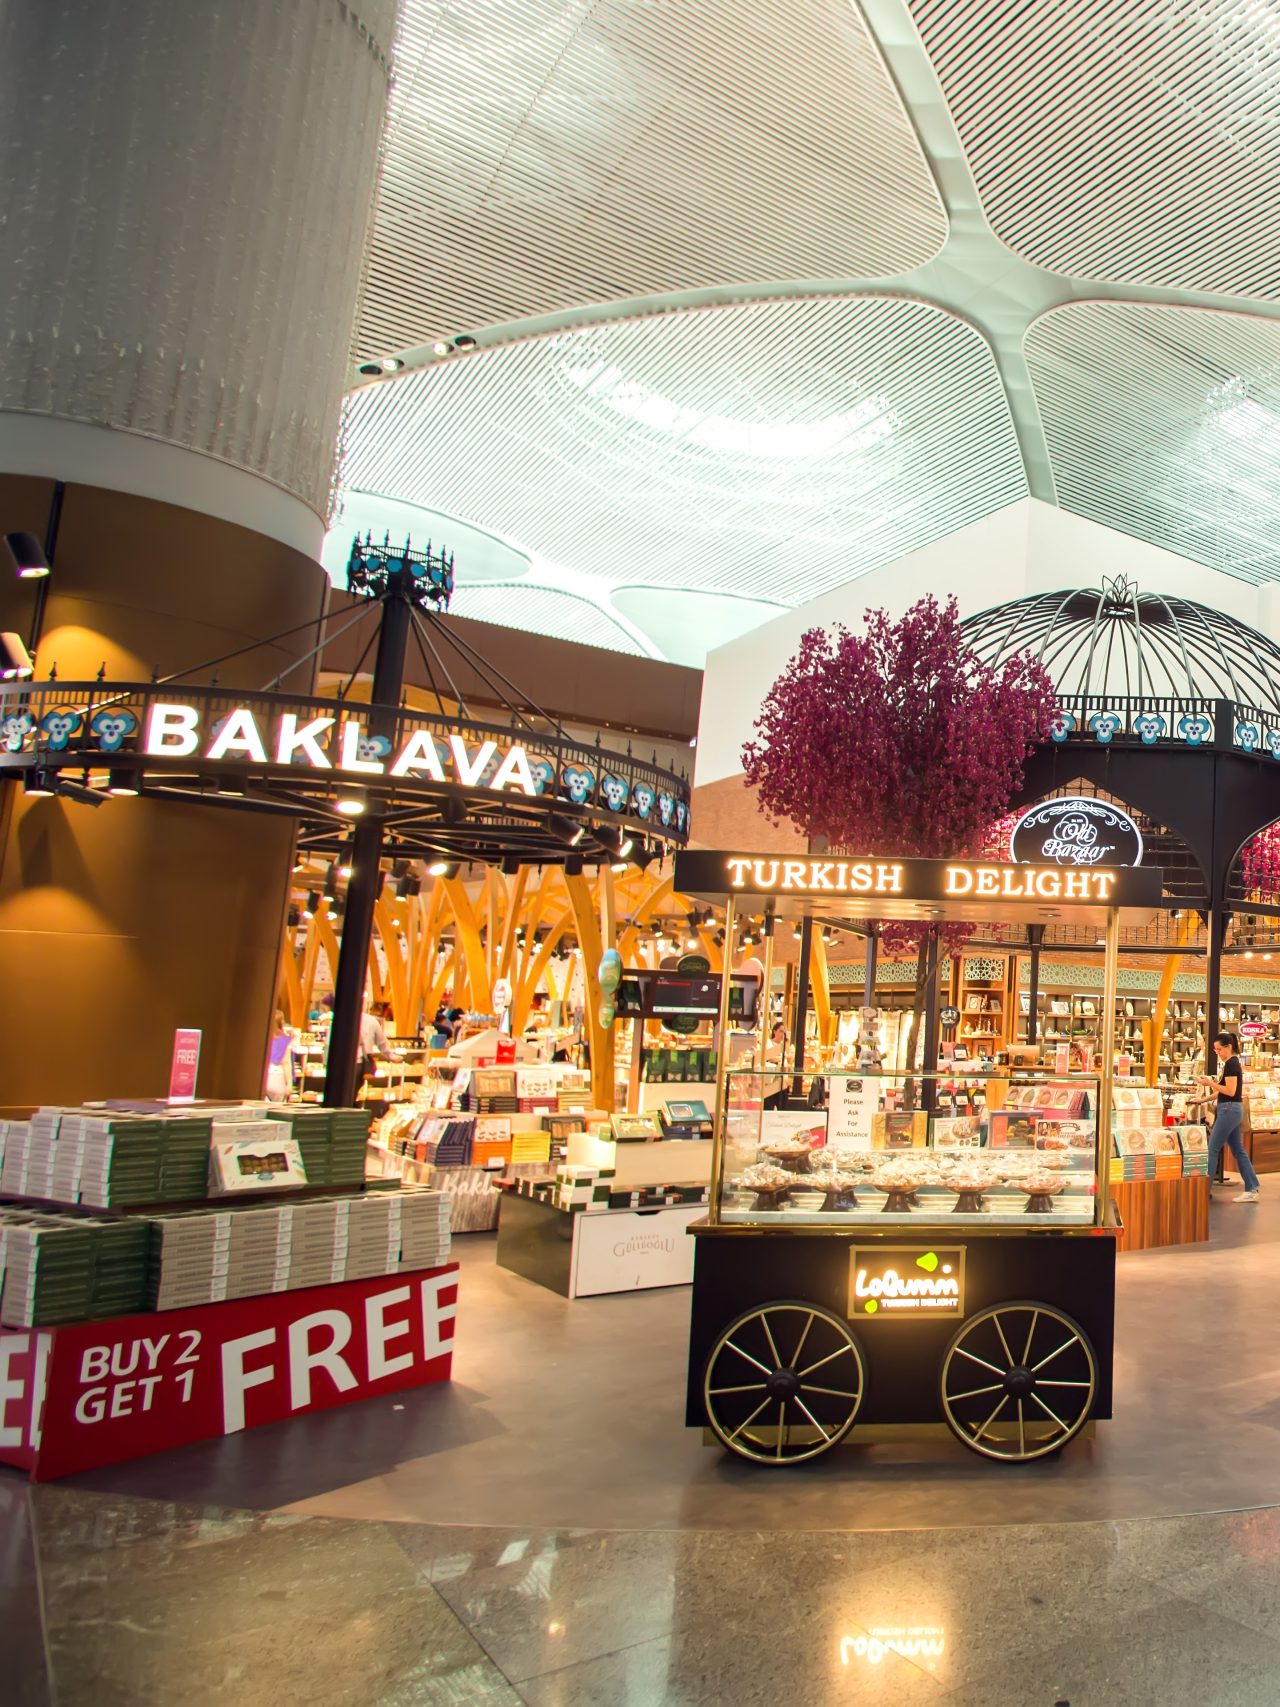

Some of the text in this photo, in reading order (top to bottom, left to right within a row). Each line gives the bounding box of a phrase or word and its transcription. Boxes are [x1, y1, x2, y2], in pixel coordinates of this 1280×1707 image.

[145, 703, 537, 797] BAKLAVA
[1053, 812, 1098, 847] Old
[726, 859, 1115, 899] TURKISH DELIGHT
[176, 1049, 197, 1065] FREE
[80, 1329, 202, 1383] BUY 2
[221, 1269, 460, 1435] FREE
[75, 1369, 194, 1424] GET 1
